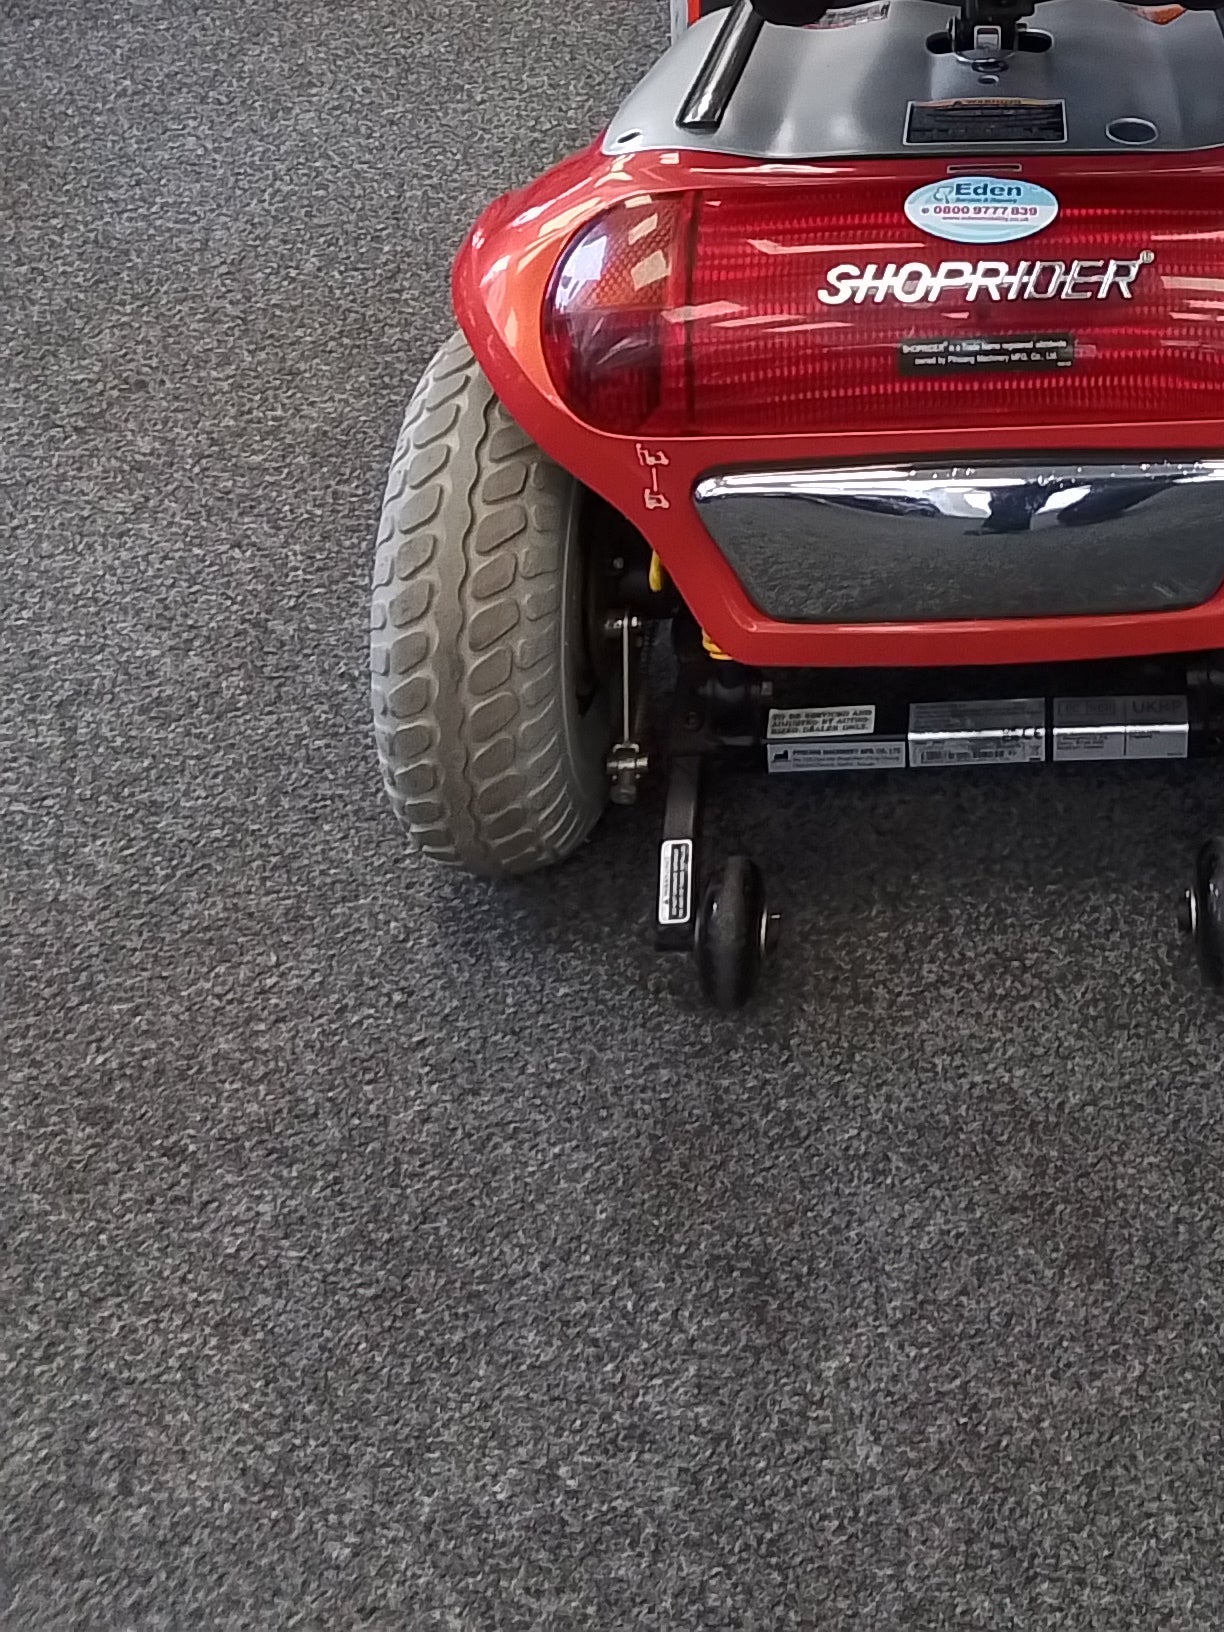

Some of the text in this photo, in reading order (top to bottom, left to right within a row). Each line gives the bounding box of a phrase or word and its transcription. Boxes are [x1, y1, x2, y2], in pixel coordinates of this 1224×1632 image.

[955, 182, 1022, 197] Eden
[933, 206, 1038, 216] 0800 9777 839
